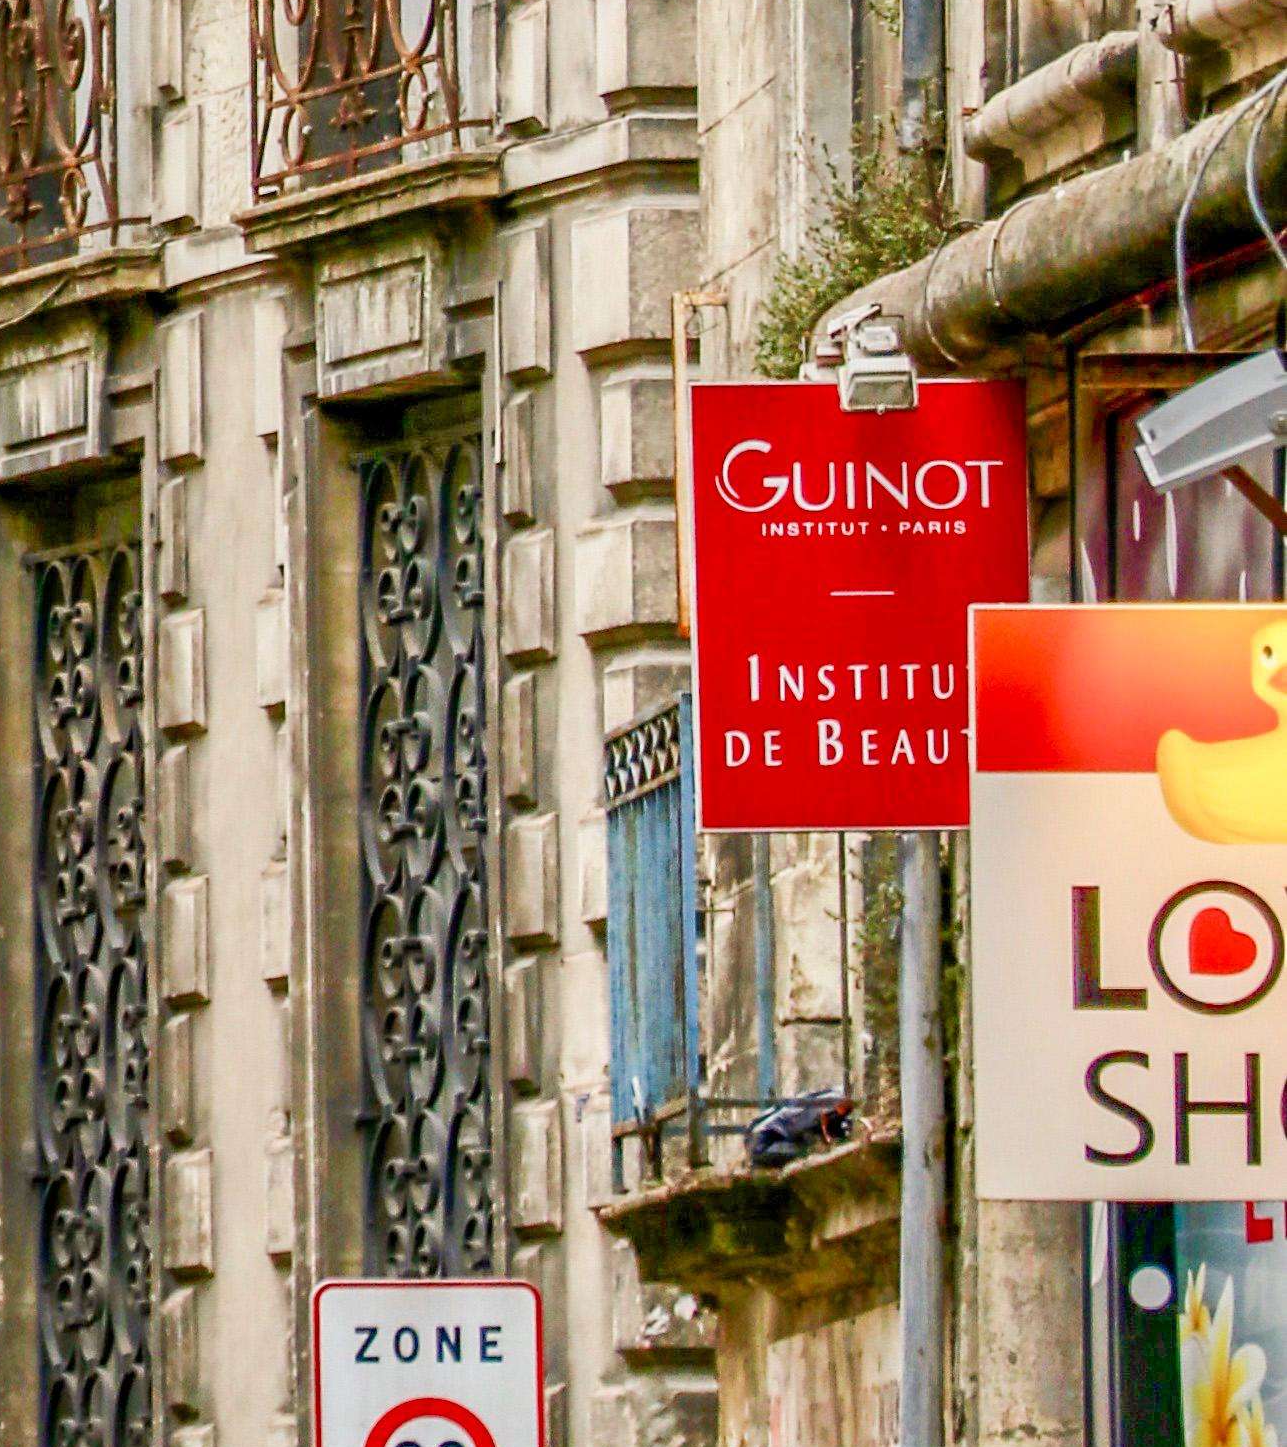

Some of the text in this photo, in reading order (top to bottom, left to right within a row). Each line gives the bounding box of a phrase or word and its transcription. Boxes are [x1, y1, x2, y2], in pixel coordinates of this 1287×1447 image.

[715, 439, 1003, 512] GUINOT
[761, 520, 967, 537] INSTITUT PARIS
[747, 654, 970, 702] INSTITU
[724, 730, 784, 767] DE
[1071, 880, 1287, 1015] LO
[1084, 1049, 1287, 1167] SH
[354, 1326, 504, 1364] ZONE
